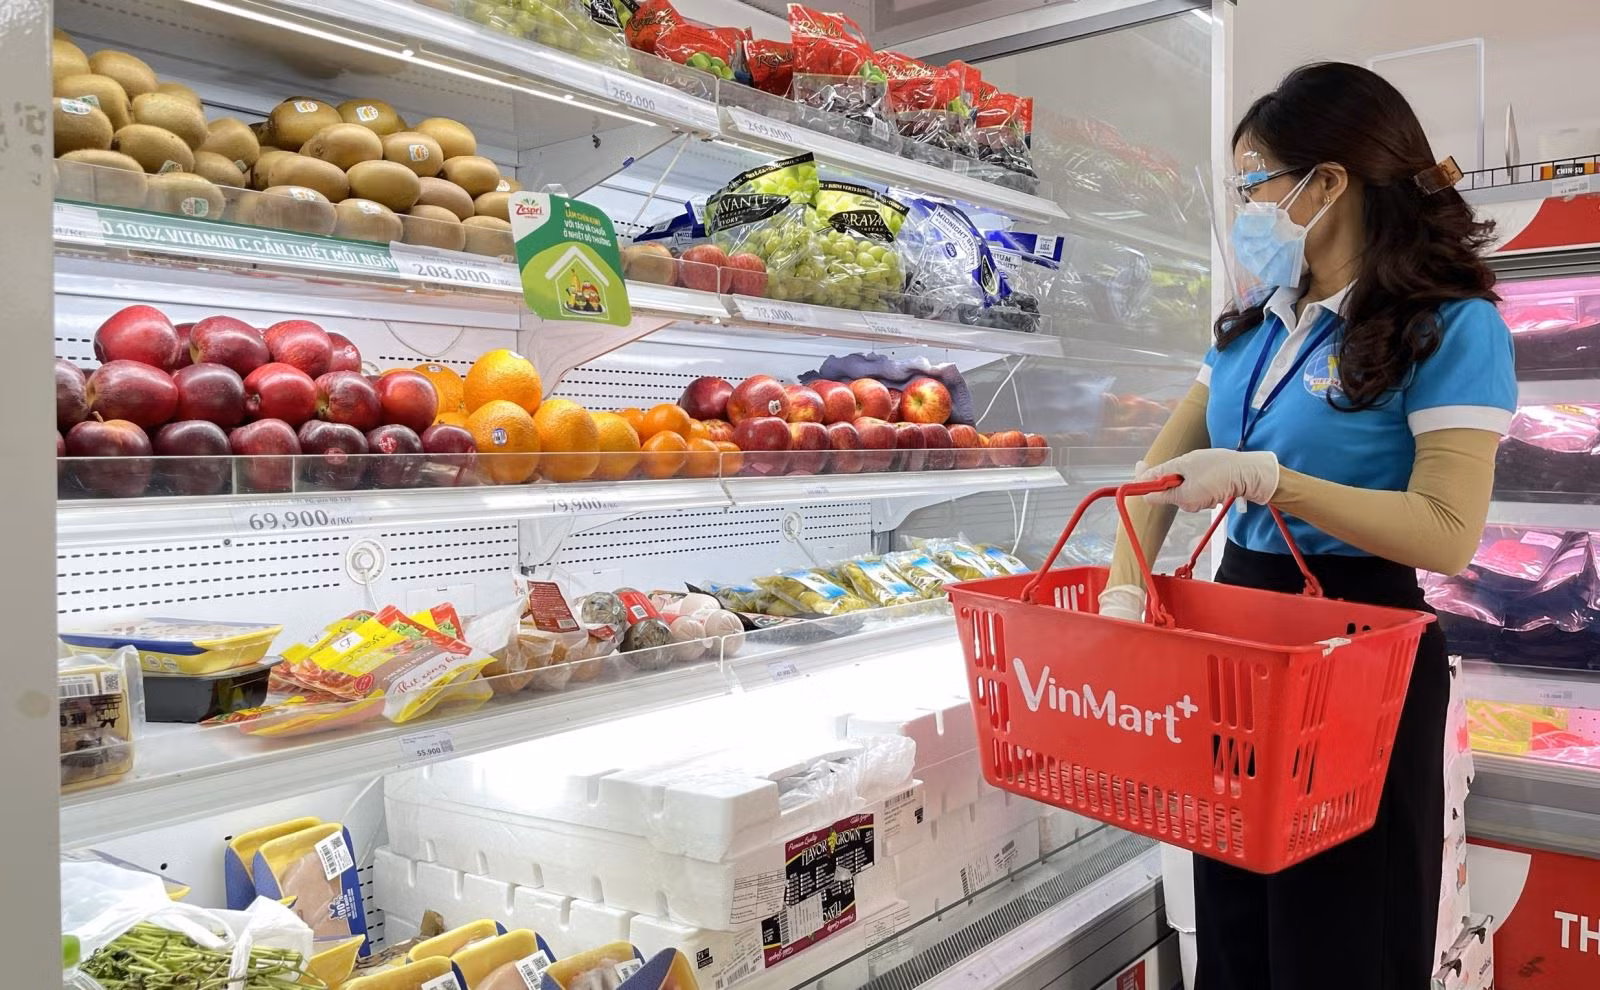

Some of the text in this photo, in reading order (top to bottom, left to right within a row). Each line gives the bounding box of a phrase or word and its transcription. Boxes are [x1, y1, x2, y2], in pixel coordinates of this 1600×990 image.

[613, 87, 655, 111] 269.000
[746, 119, 793, 142] 269.000
[515, 203, 544, 216] Zespri
[117, 223, 166, 242] 100%
[165, 228, 236, 250] VITAMIN
[238, 237, 252, 251] C
[253, 235, 289, 257] CẦN
[288, 242, 329, 261] THIẾT
[329, 246, 357, 264] MỖI
[413, 263, 492, 284] 208.000
[549, 496, 601, 514] 79,900
[249, 509, 329, 530] 69,900
[801, 839, 828, 867] FLAVOR
[835, 827, 861, 846] GROWN
